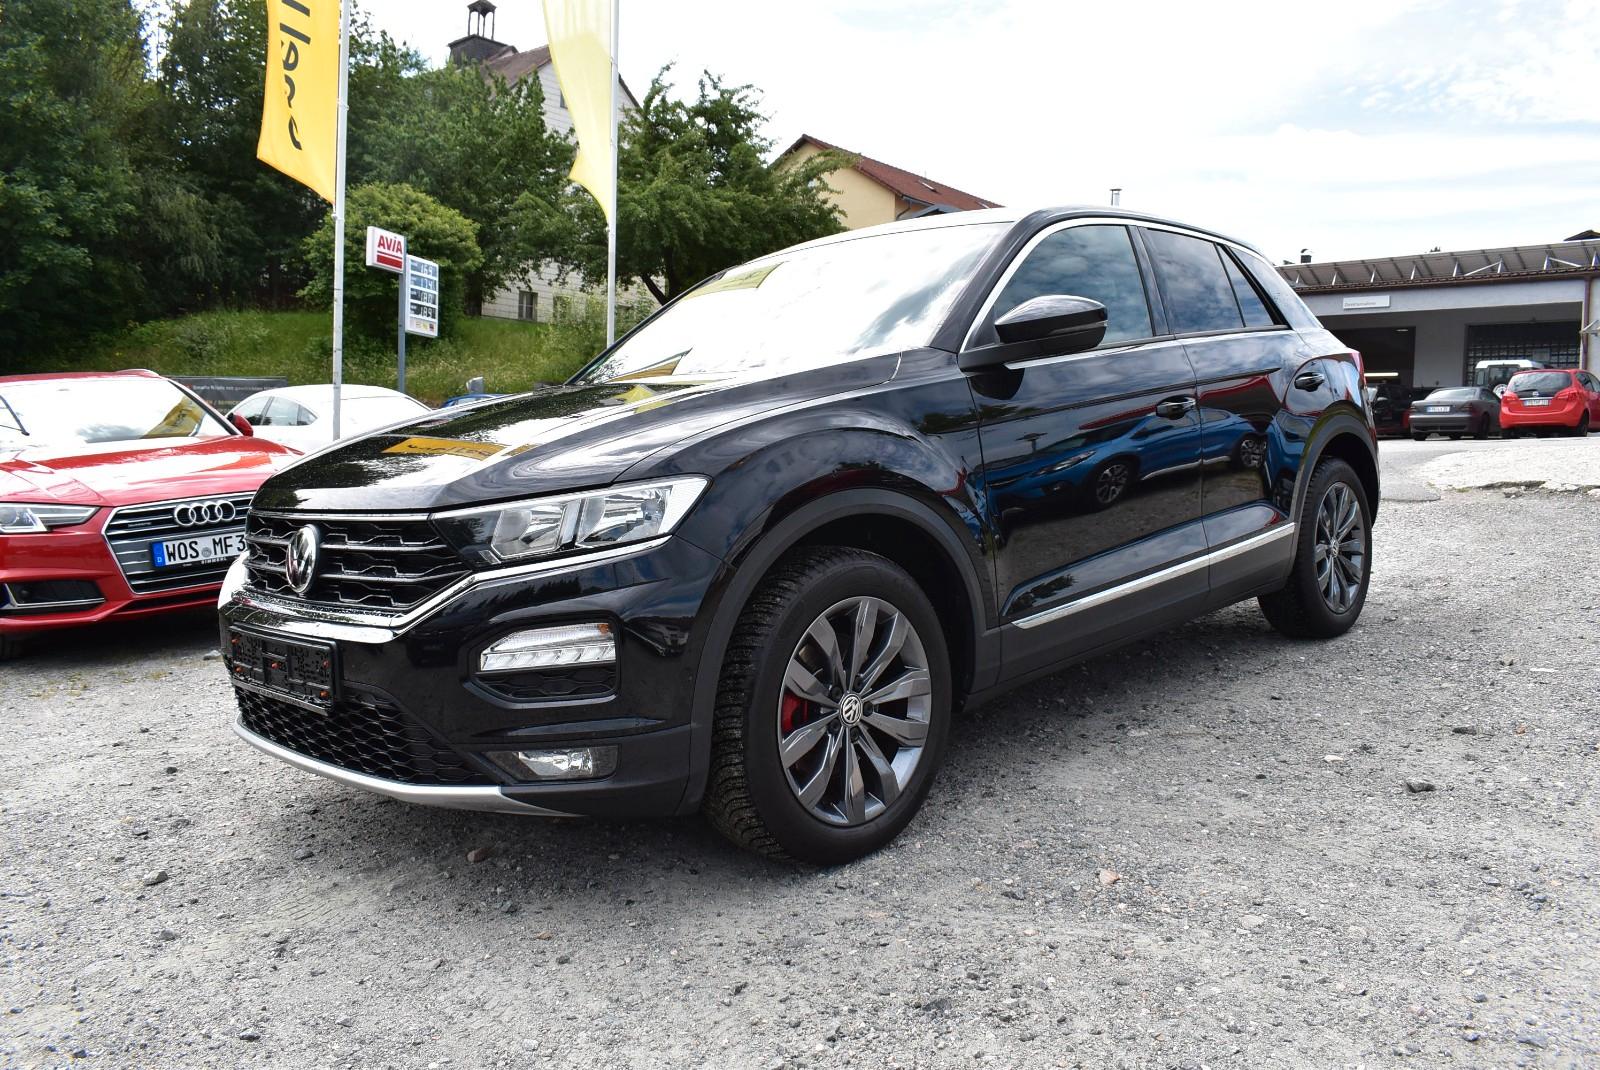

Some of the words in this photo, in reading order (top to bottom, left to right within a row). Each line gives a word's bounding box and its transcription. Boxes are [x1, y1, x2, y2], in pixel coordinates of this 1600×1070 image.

[377, 235, 403, 255] AVIA
[165, 541, 200, 562] WOS
[212, 536, 233, 555] MF
